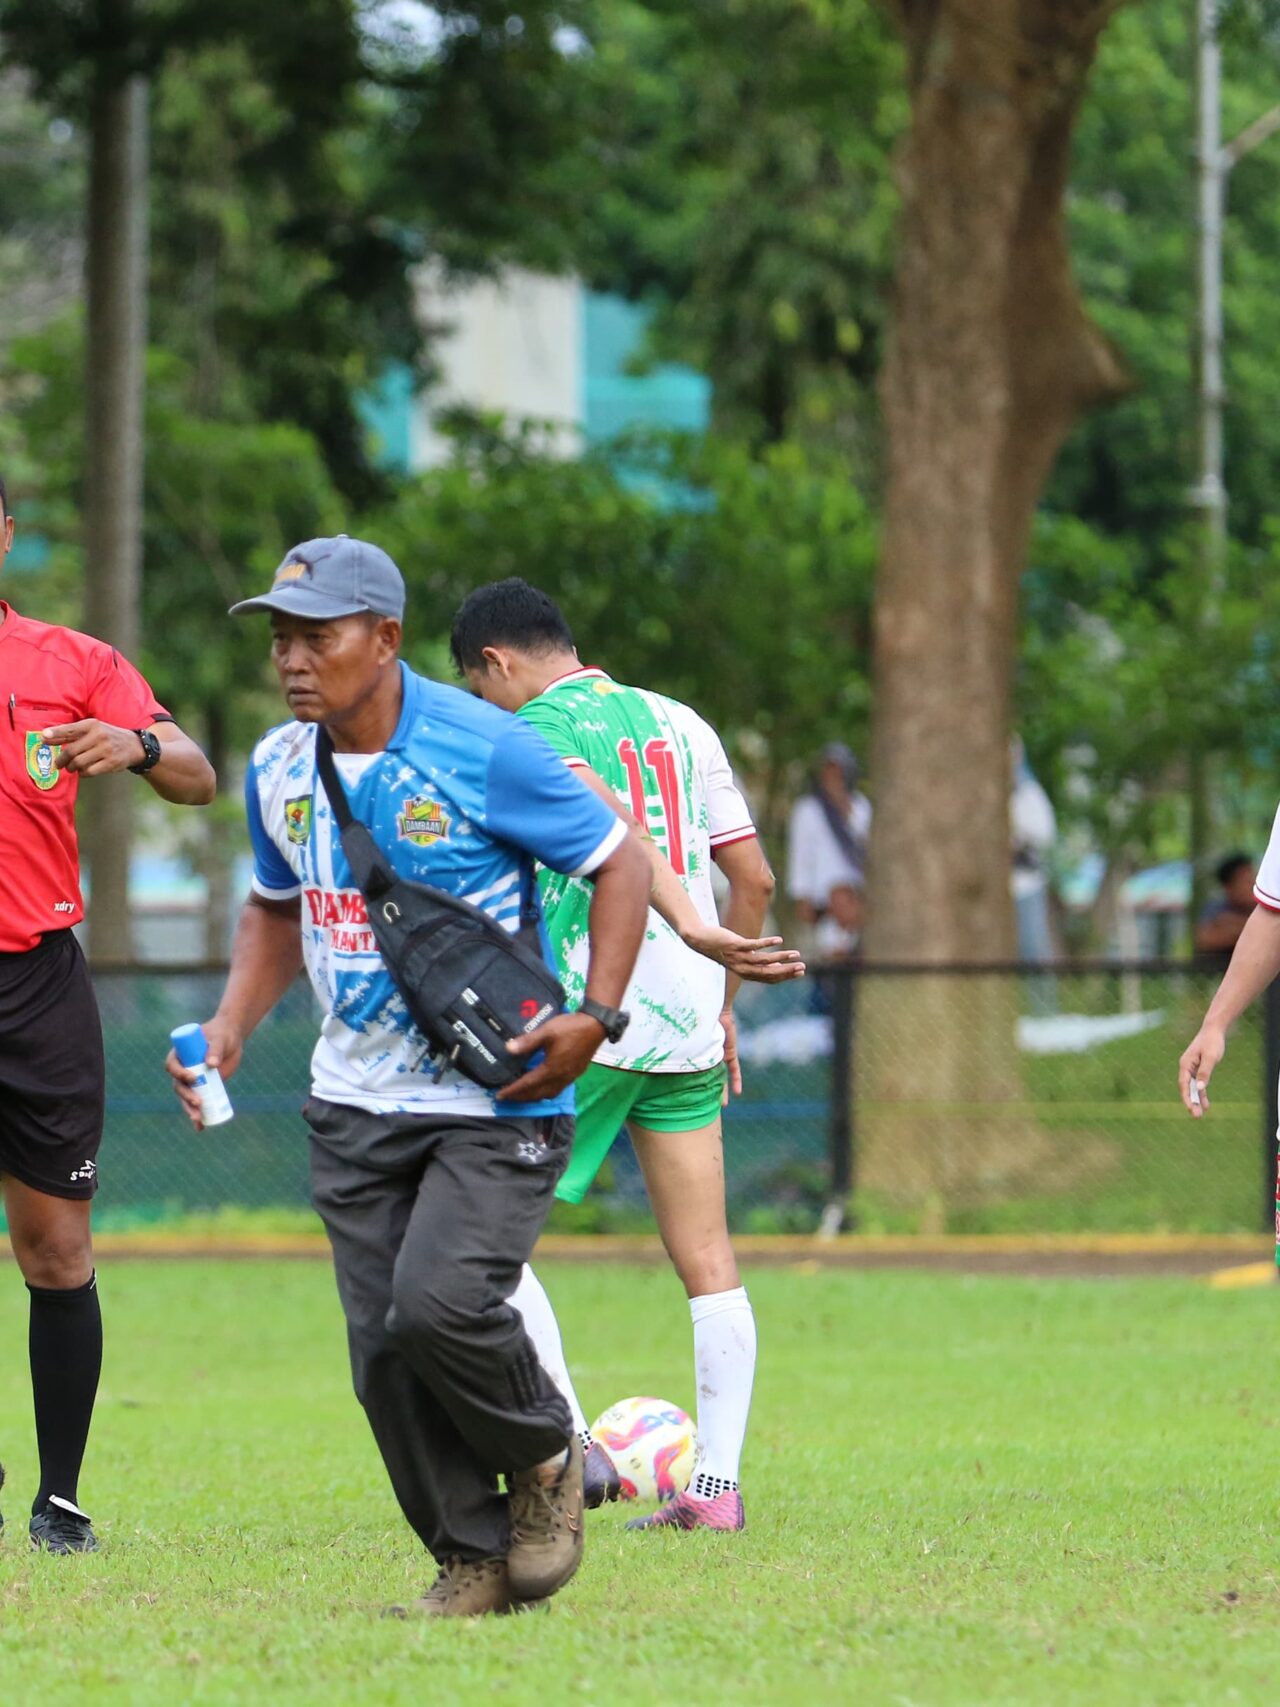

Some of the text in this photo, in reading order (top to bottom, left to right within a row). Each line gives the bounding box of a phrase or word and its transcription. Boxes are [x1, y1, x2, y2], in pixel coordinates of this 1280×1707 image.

[618, 737, 686, 876] 11
[405, 820, 441, 833] DAMBAAN
[54, 900, 75, 914] xdry
